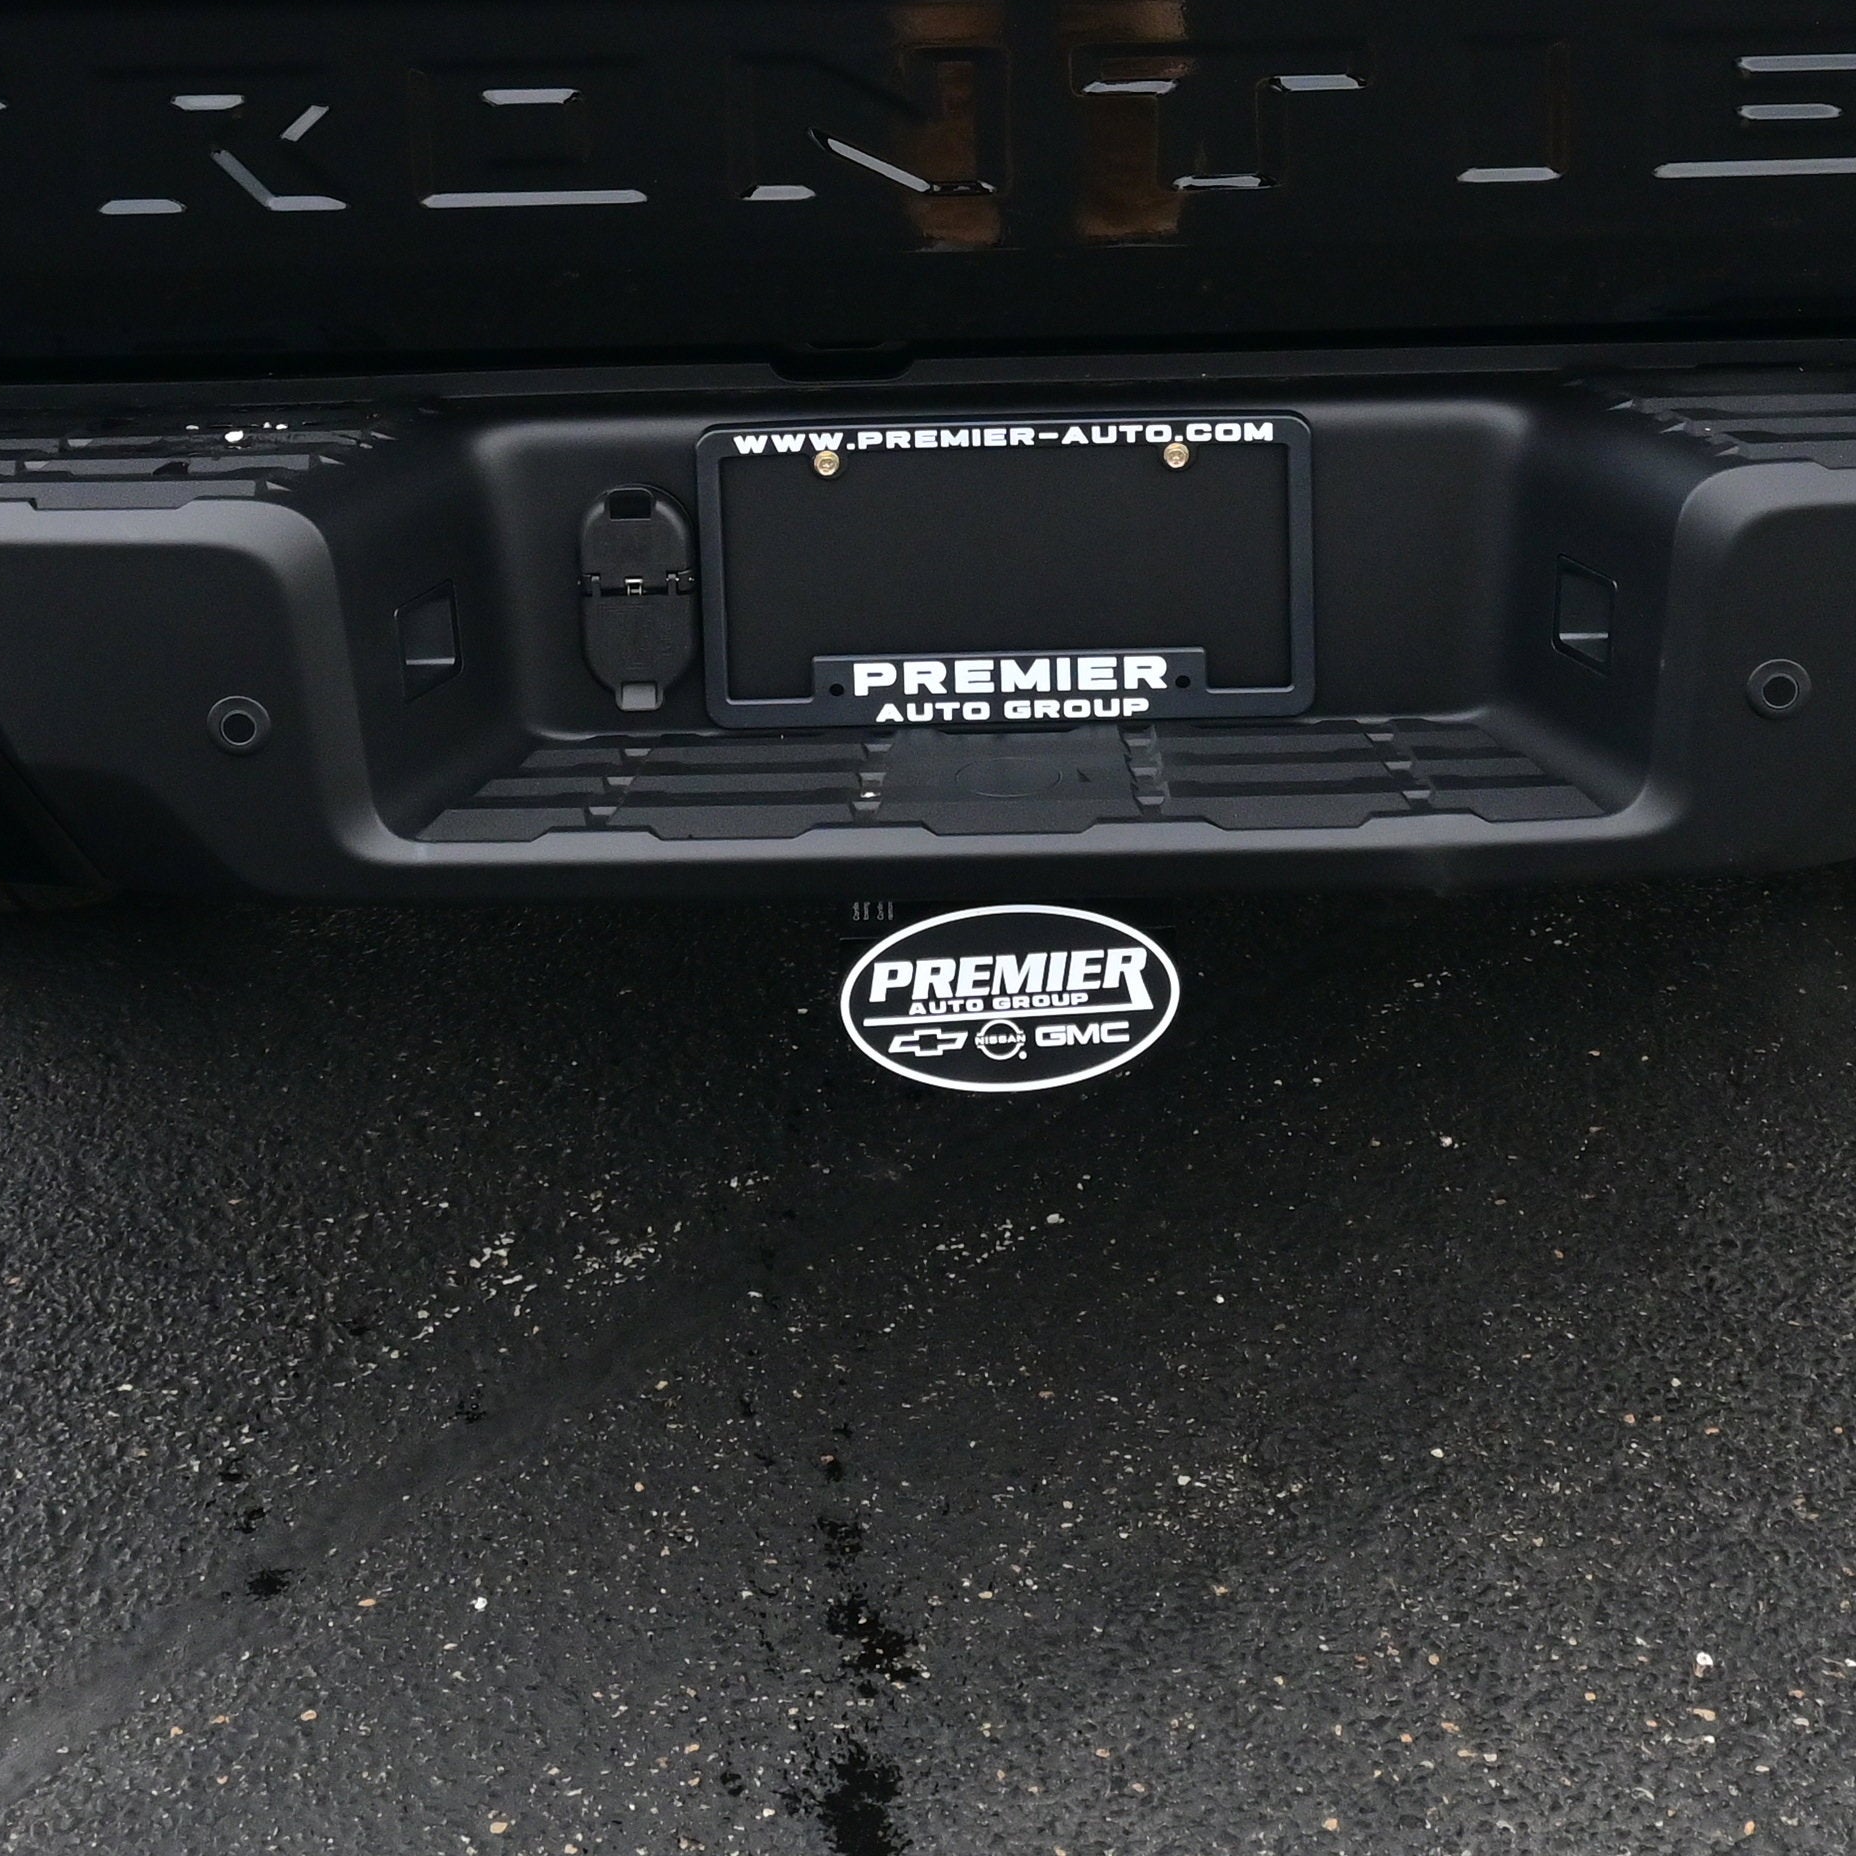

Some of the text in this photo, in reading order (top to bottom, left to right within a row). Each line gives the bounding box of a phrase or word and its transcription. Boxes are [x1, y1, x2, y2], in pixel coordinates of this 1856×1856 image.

[733, 422, 1274, 455] WWW.PREMIER-AUTO.COM
[852, 655, 1169, 698] PREMIER
[875, 697, 1150, 724] AUTO GROUP
[868, 946, 1153, 1010] PREMIER
[908, 992, 1089, 1016] AUTO GROUP
[974, 1033, 1027, 1046] NISSAN
[1034, 1020, 1131, 1048] GMC
